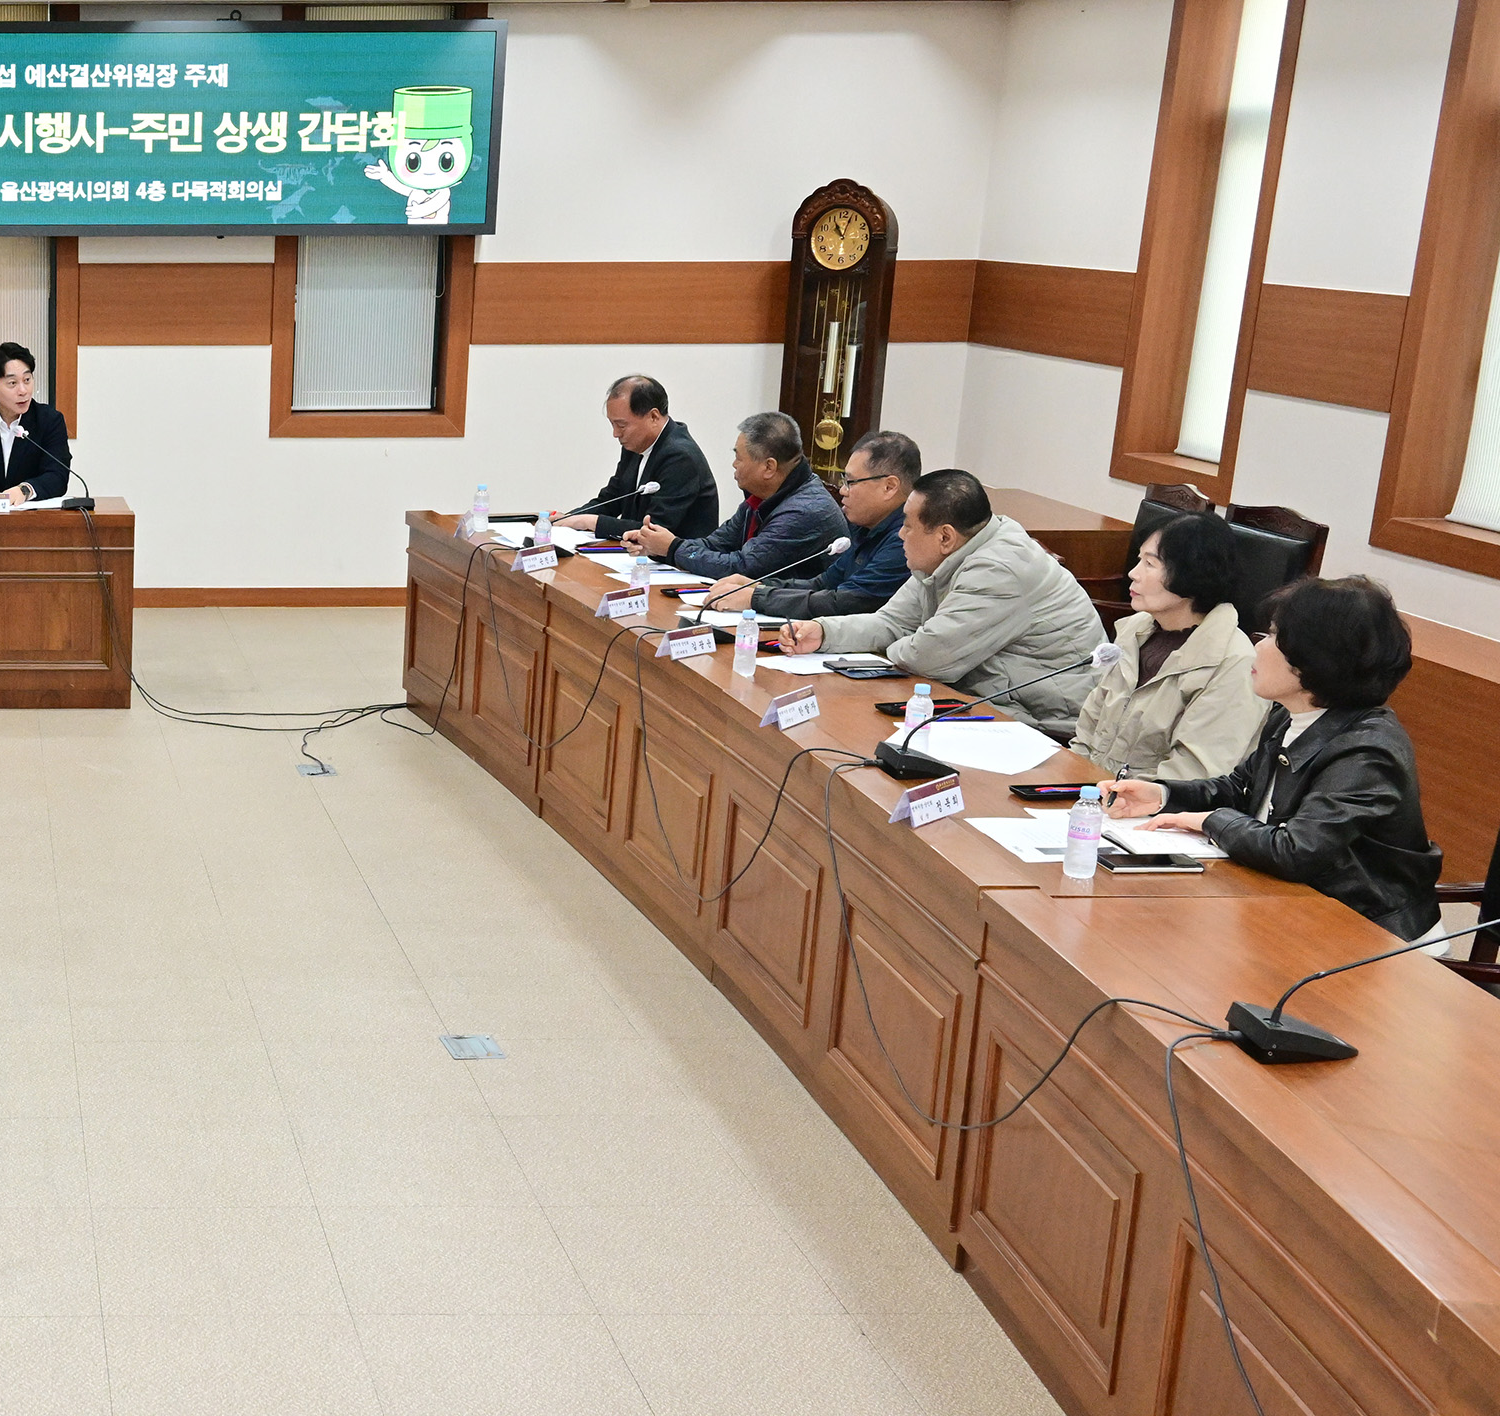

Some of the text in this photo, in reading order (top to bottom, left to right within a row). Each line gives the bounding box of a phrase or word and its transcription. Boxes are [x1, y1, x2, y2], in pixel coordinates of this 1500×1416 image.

[24, 63, 179, 88] 예산결산위원장
[184, 63, 229, 88] 주재
[213, 111, 288, 154] 상생
[297, 110, 407, 154] 간담회
[0, 180, 283, 202] 울산광역시의회 4층 다목적회의실
[839, 210, 849, 219] 12
[854, 214, 858, 222] 1
[828, 215, 837, 223] 11
[820, 223, 829, 232] 10
[859, 222, 866, 230] 2
[817, 234, 824, 243] 9
[861, 233, 869, 241] 3
[819, 245, 826, 253] 8
[827, 253, 834, 261] 7
[837, 256, 844, 264] 6
[848, 253, 857, 261] 5
